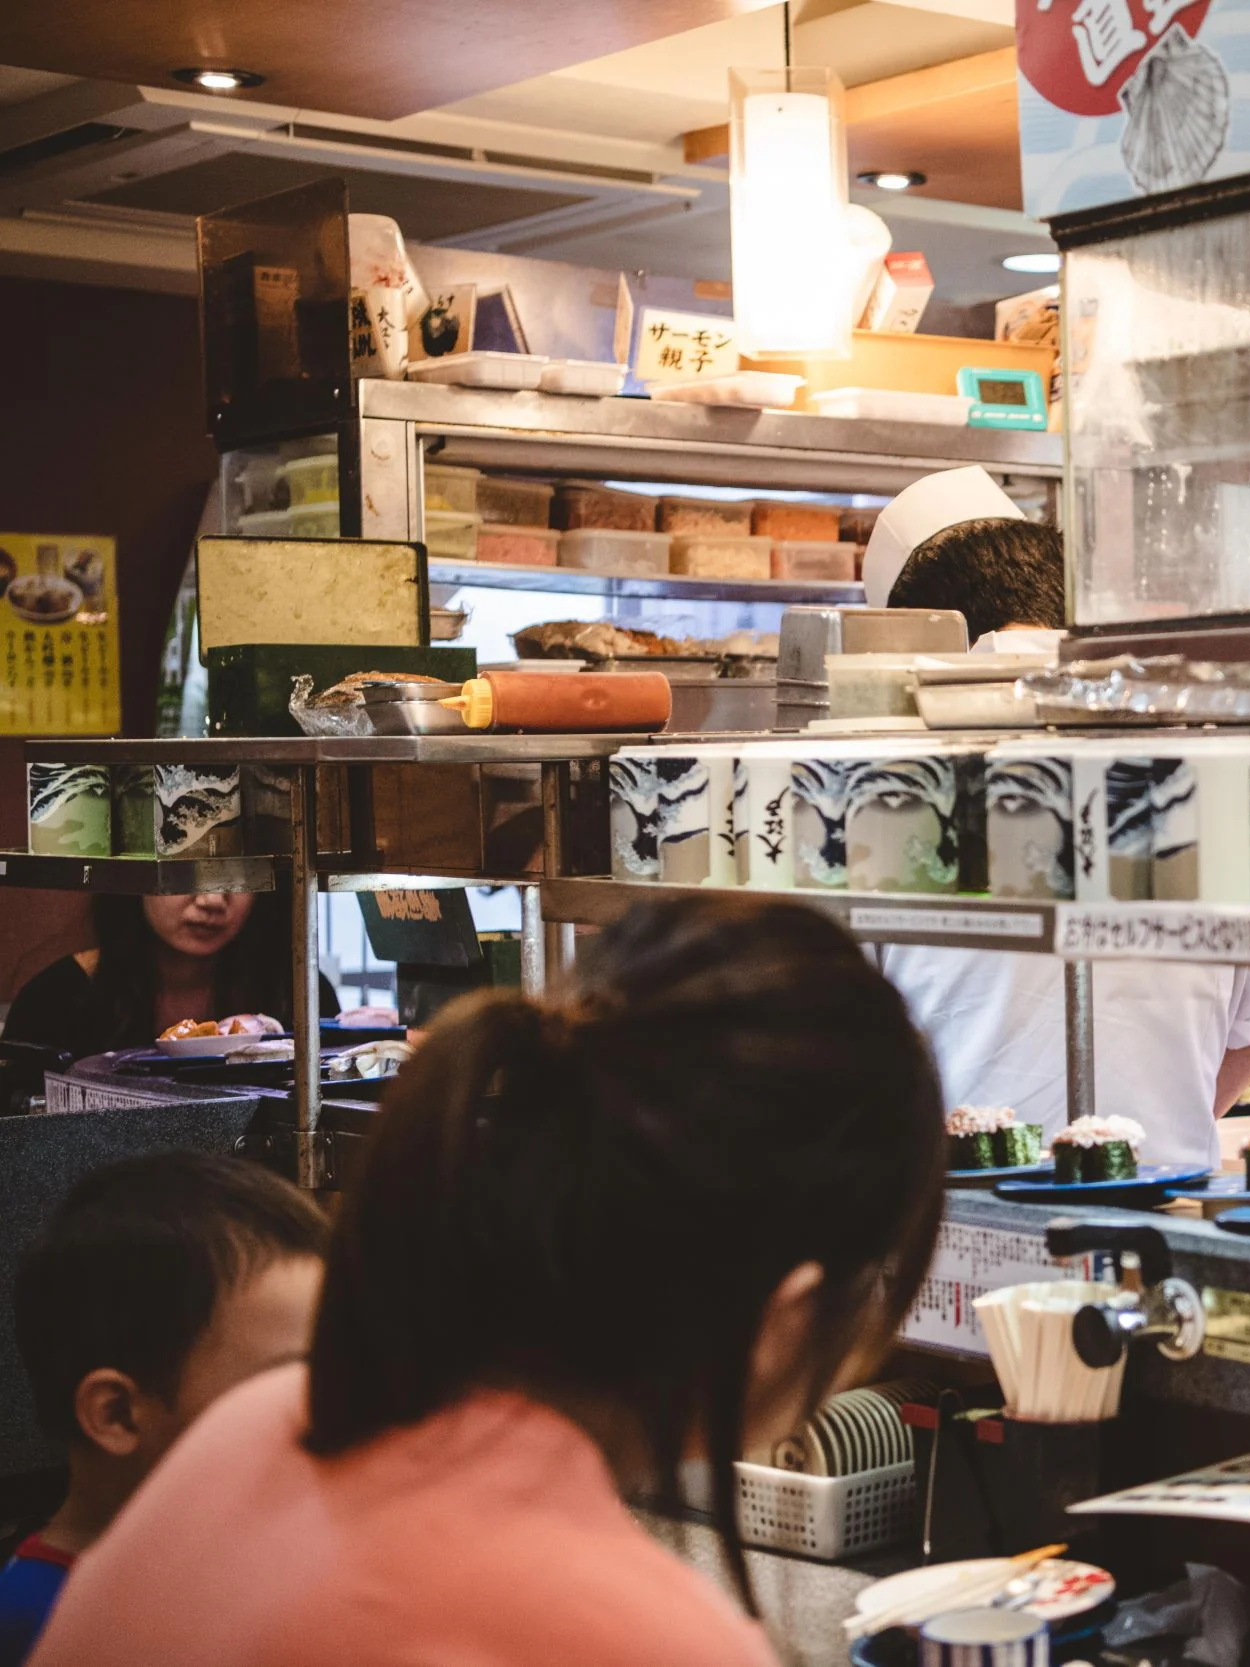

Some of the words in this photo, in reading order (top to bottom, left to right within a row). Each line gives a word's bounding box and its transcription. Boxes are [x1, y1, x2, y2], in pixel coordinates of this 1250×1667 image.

[648, 322, 732, 349] サーモン
[658, 344, 713, 372] 親子
[756, 785, 790, 864] 大江戸
